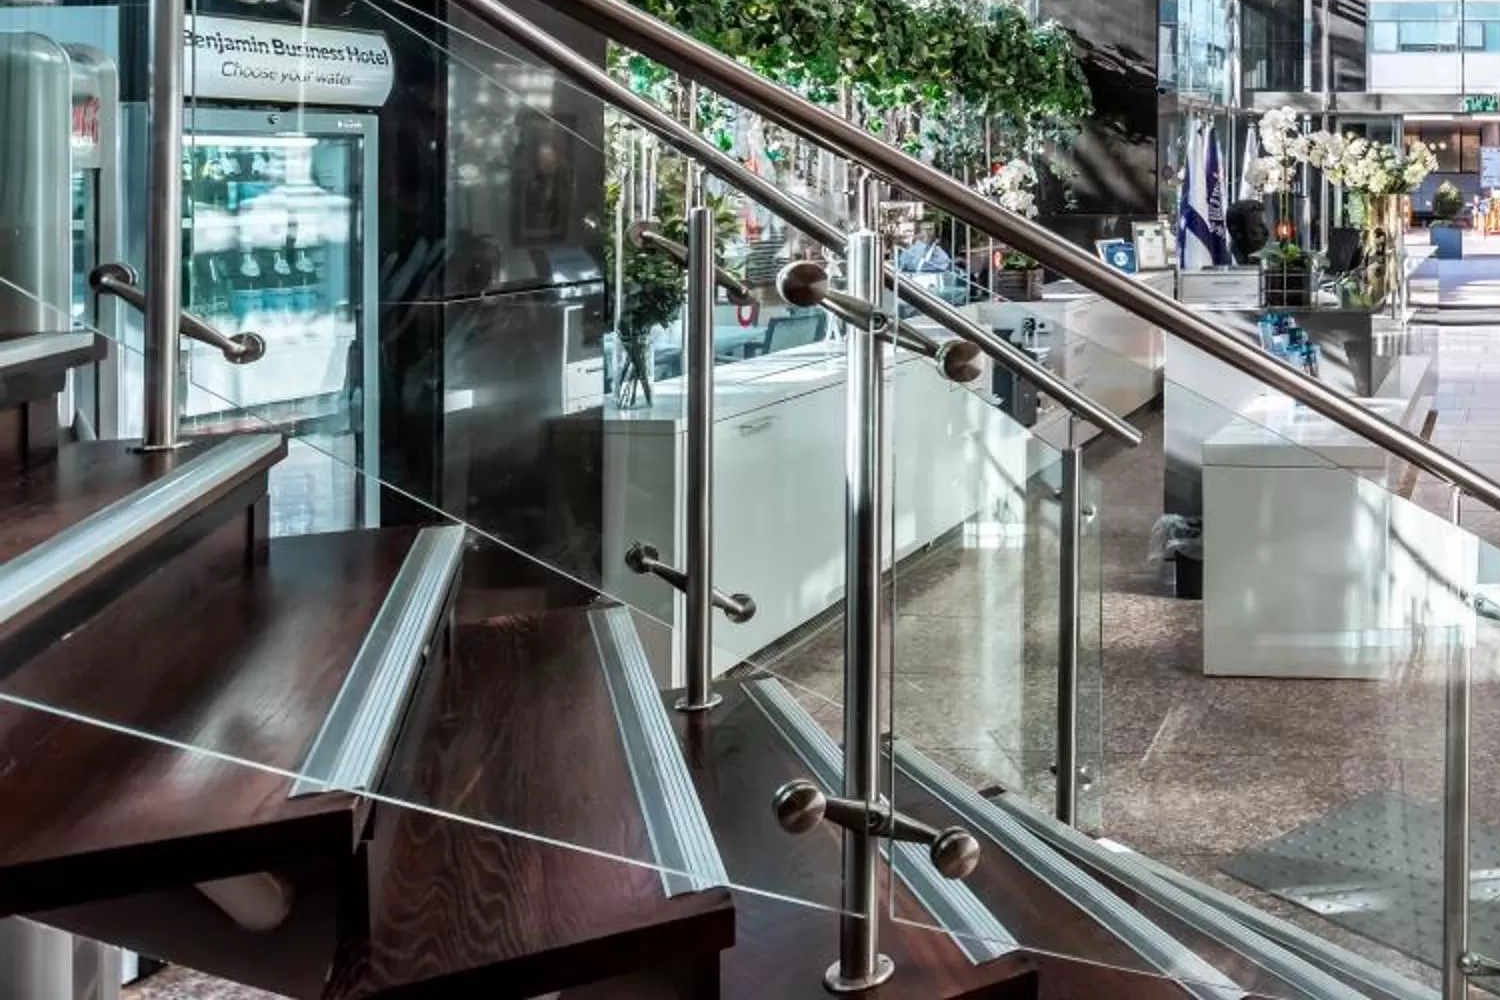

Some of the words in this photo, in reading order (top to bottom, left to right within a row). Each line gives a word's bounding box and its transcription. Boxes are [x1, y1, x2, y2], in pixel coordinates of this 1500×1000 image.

[184, 29, 270, 55] Benjamin
[272, 38, 345, 61] Business
[348, 45, 389, 66] Hotel
[221, 60, 276, 81] Choose
[280, 69, 314, 84] your
[316, 70, 351, 86] water
